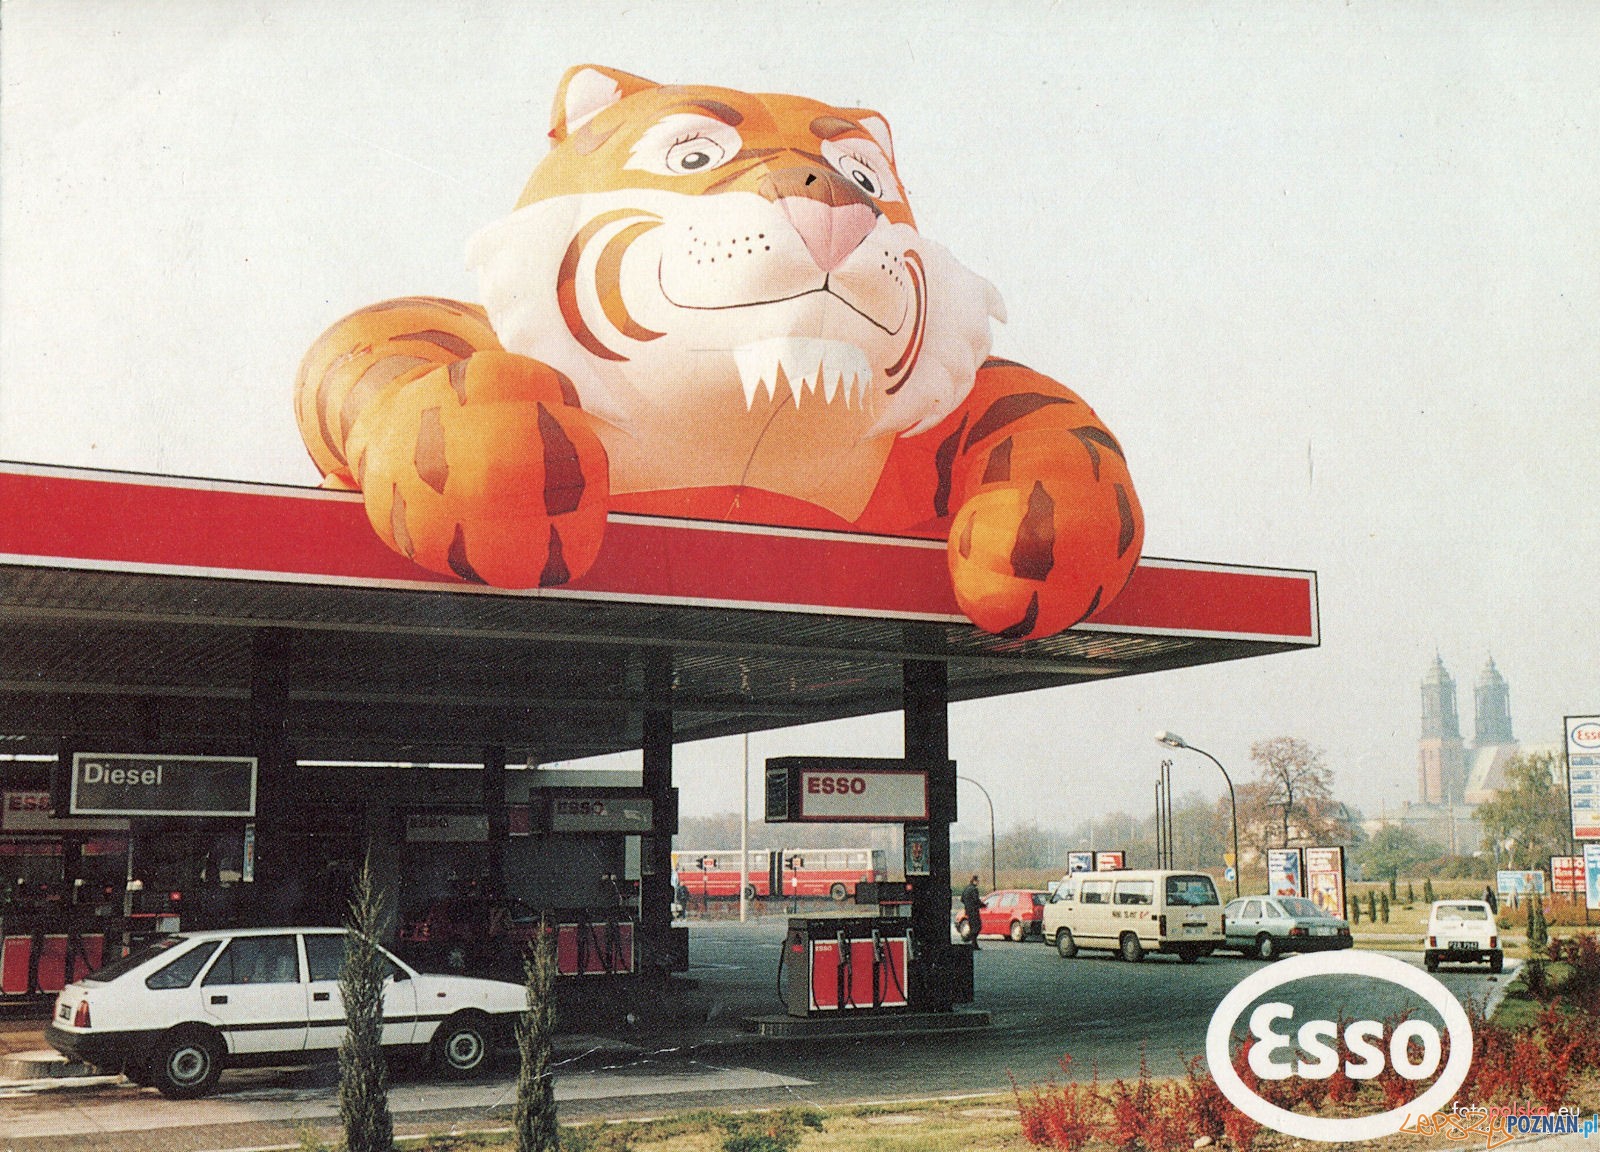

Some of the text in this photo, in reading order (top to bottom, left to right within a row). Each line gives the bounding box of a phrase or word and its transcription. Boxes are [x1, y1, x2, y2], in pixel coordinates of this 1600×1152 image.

[84, 763, 163, 785] Diesel
[808, 777, 866, 794] ESSO
[9, 796, 50, 811] ESS
